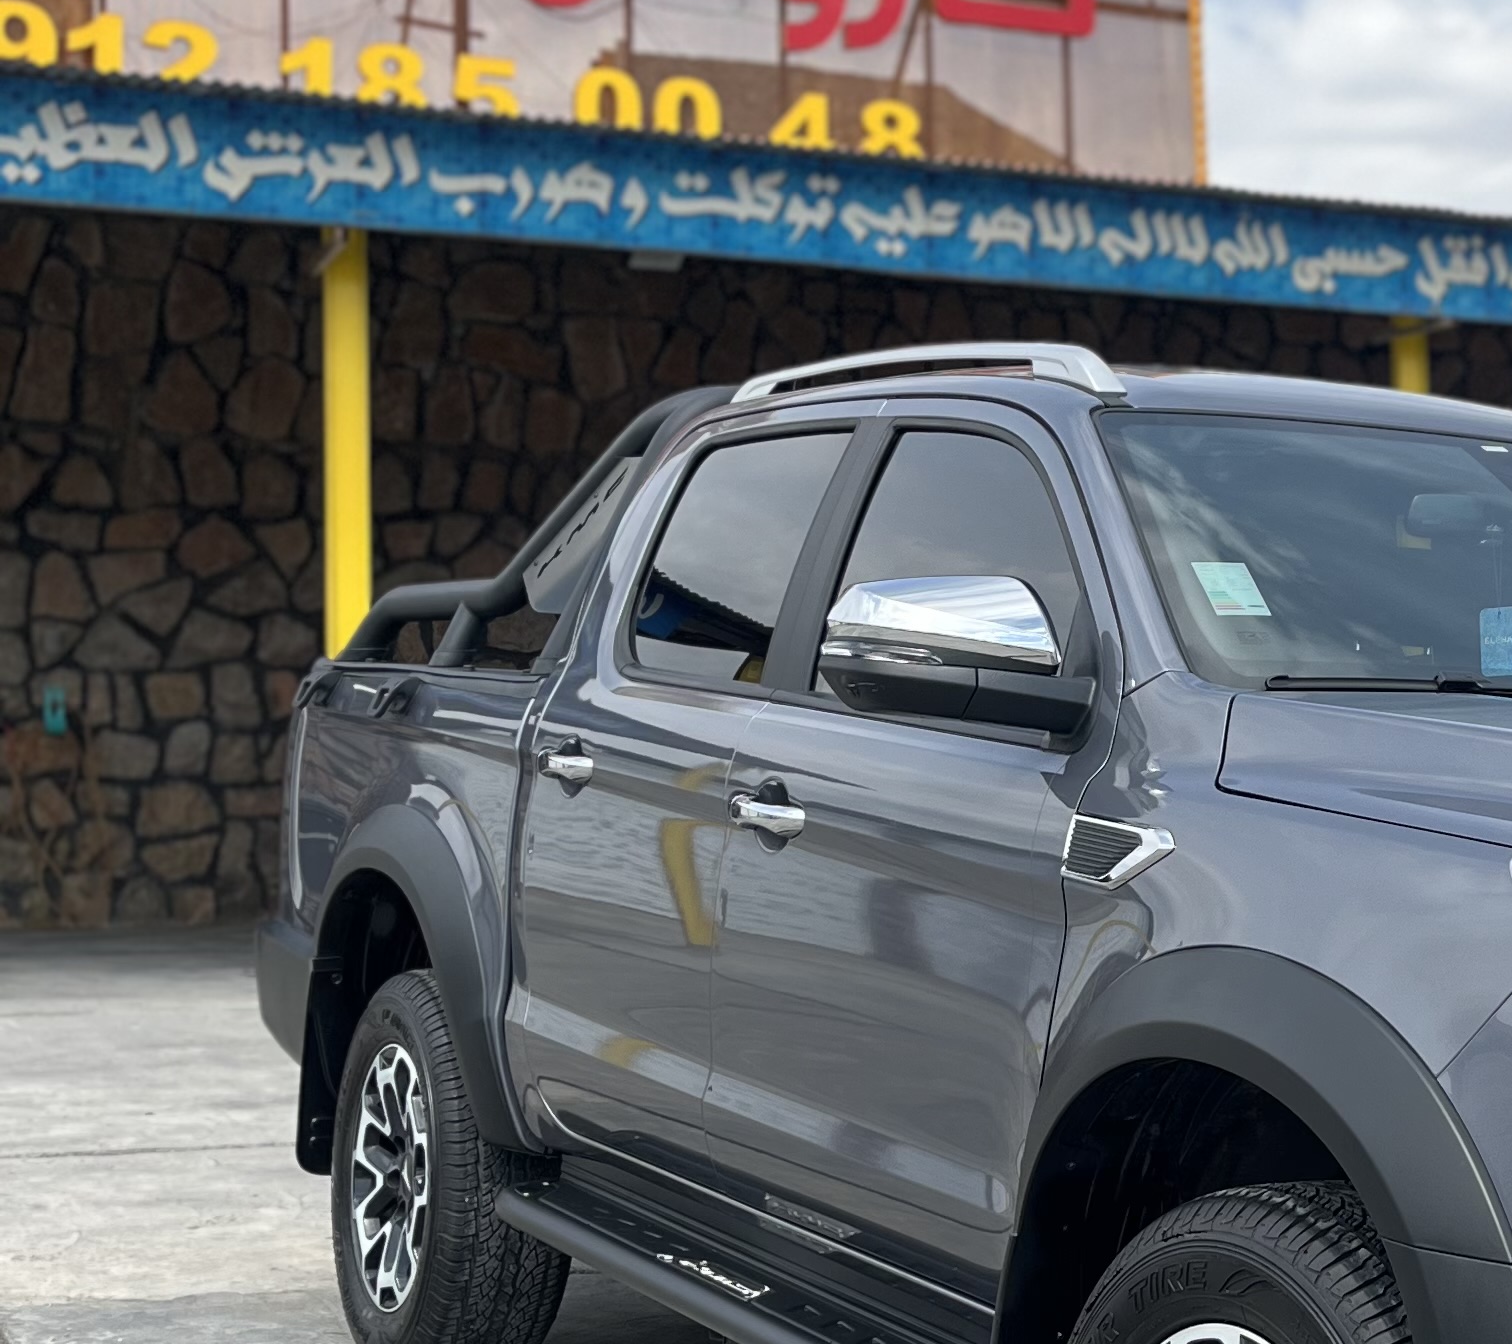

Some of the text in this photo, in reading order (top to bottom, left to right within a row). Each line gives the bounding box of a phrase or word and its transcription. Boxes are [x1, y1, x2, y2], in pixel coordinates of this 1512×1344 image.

[0, 102, 198, 184] العظی
[769, 92, 923, 158] 48
[203, 128, 420, 203] العرش
[1127, 1260, 1209, 1314] TIRE
